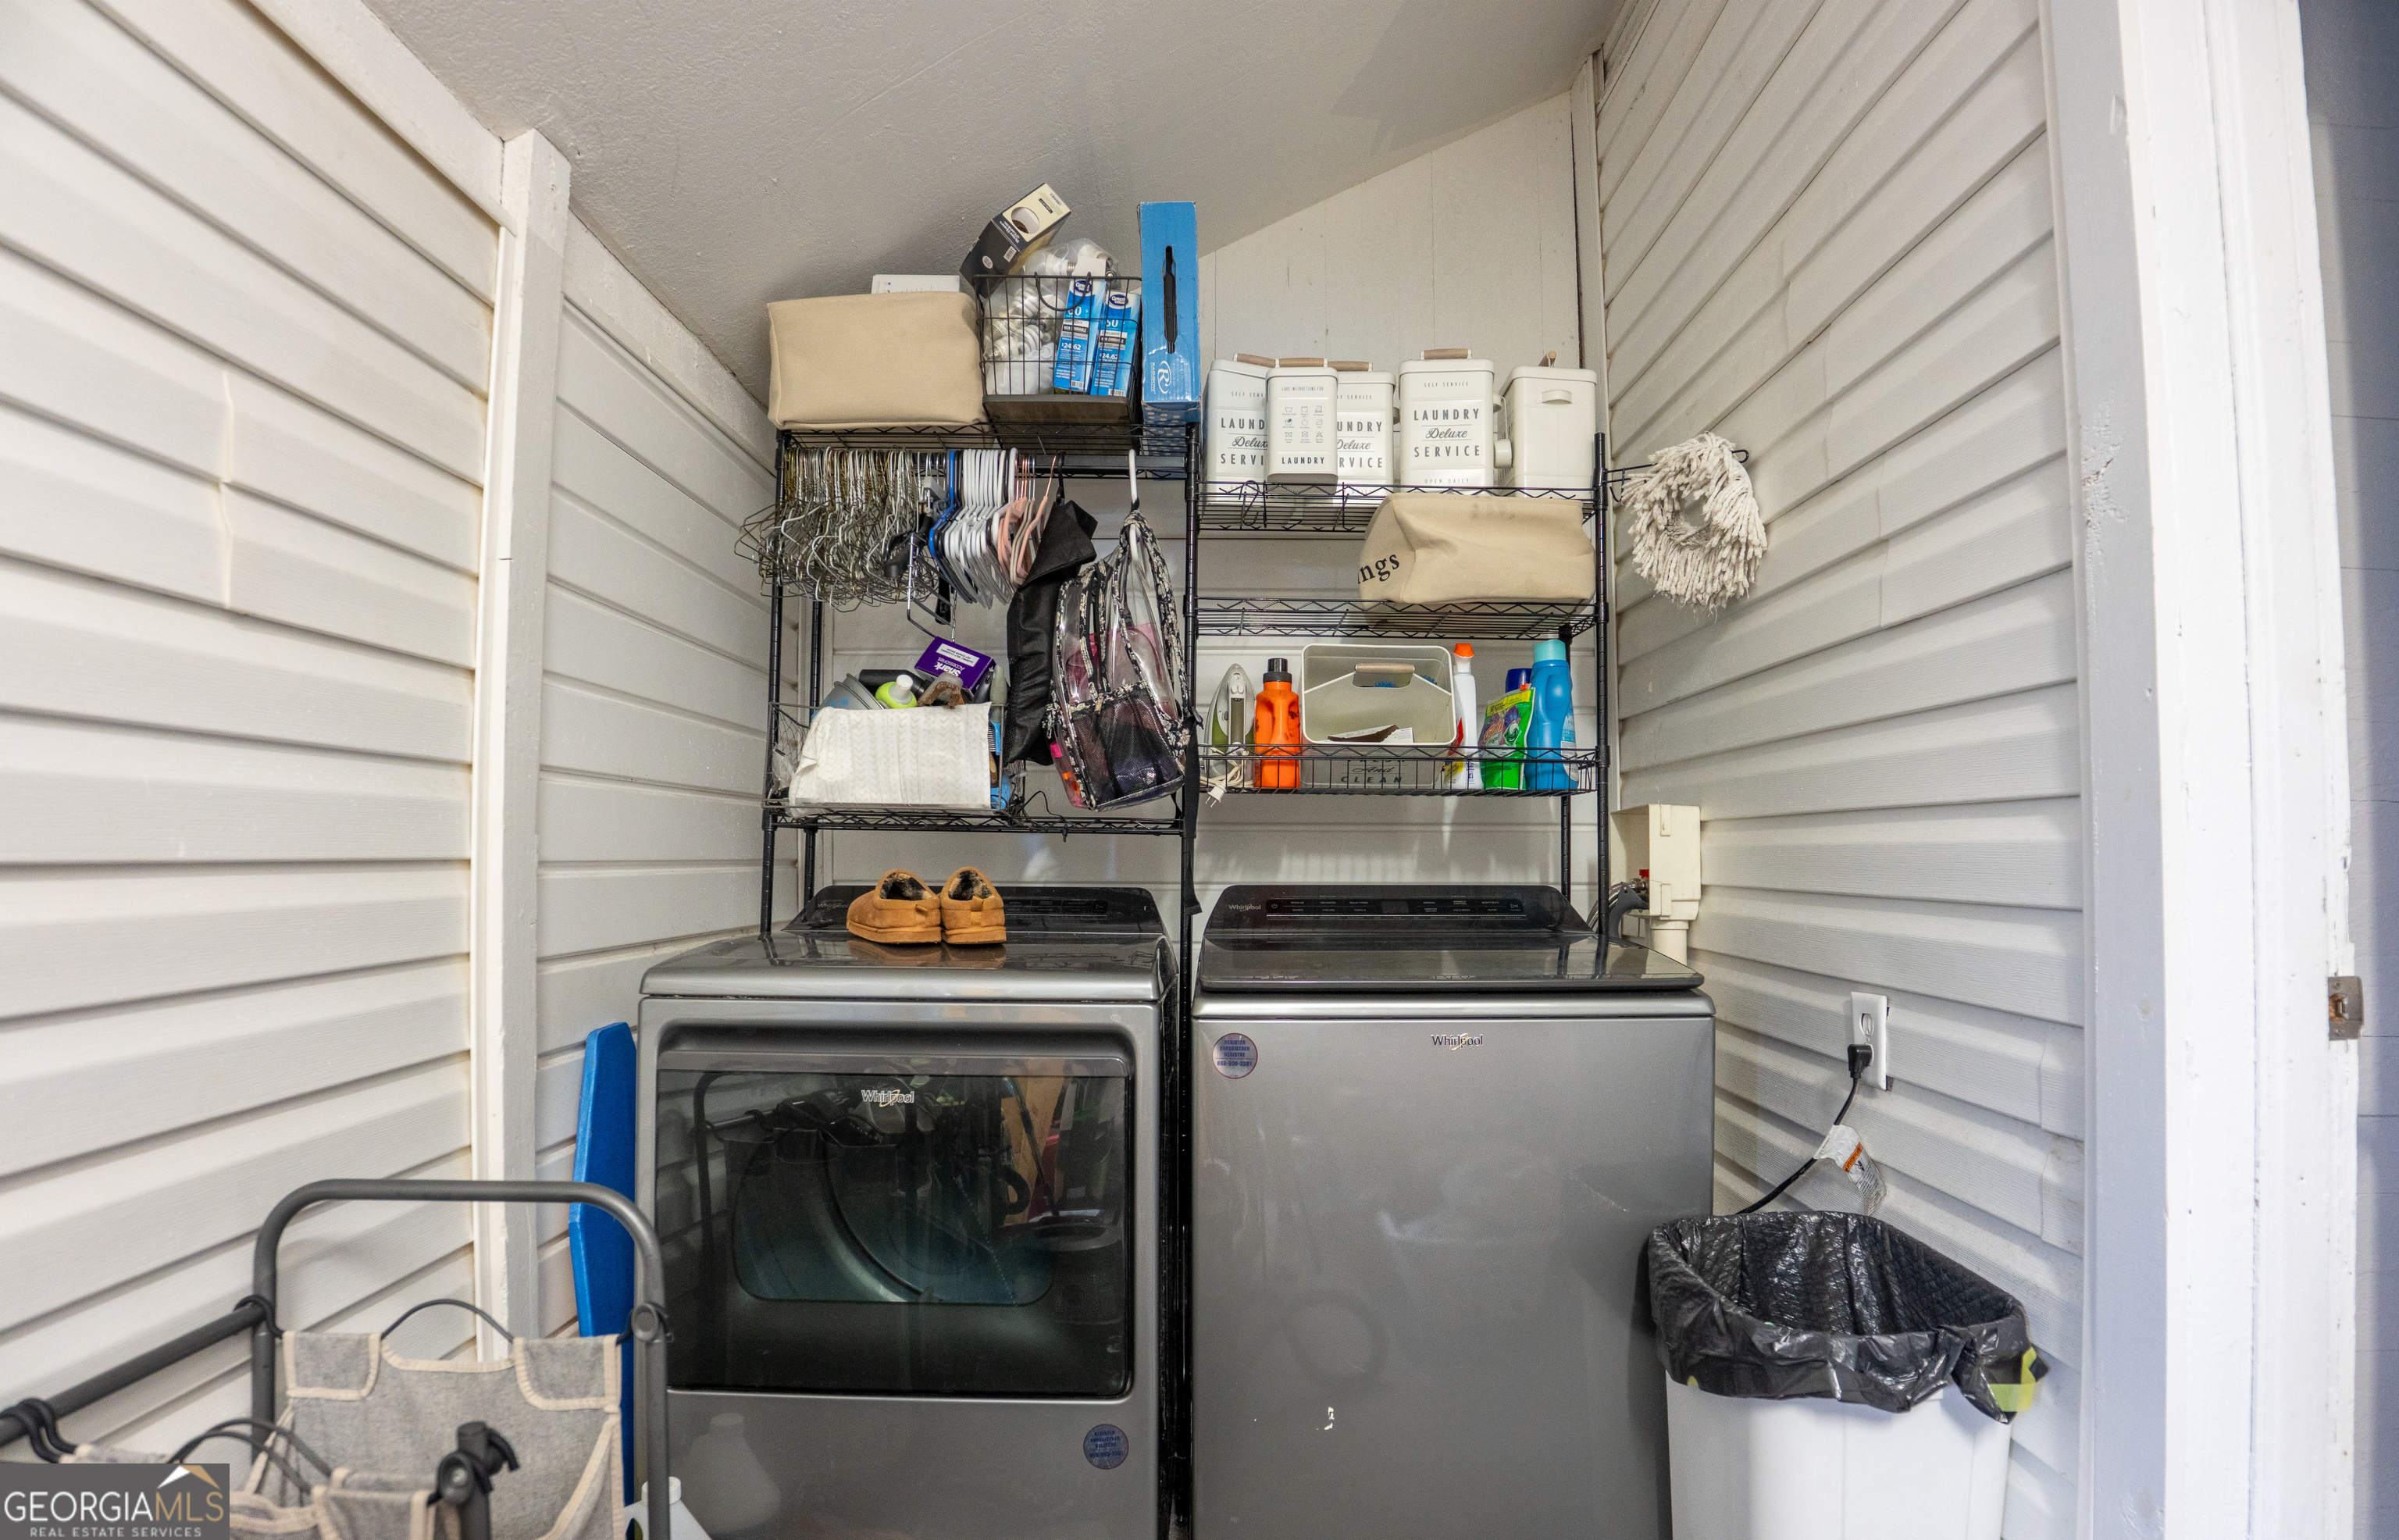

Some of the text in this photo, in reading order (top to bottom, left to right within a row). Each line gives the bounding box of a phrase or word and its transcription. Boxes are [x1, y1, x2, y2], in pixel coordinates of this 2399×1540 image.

[1414, 408, 1479, 421] LAUNDRY
[1221, 418, 1265, 430] LAUND
[1425, 427, 1468, 439] Deluxe
[1414, 445, 1480, 458] SERVICE
[1221, 454, 1264, 465] SERVI
[1339, 457, 1382, 468] RVICE
[1228, 904, 1261, 912] Whirlpool
[1431, 1034, 1483, 1050] Whirlpool
[861, 1089, 915, 1107] Whirlpool
